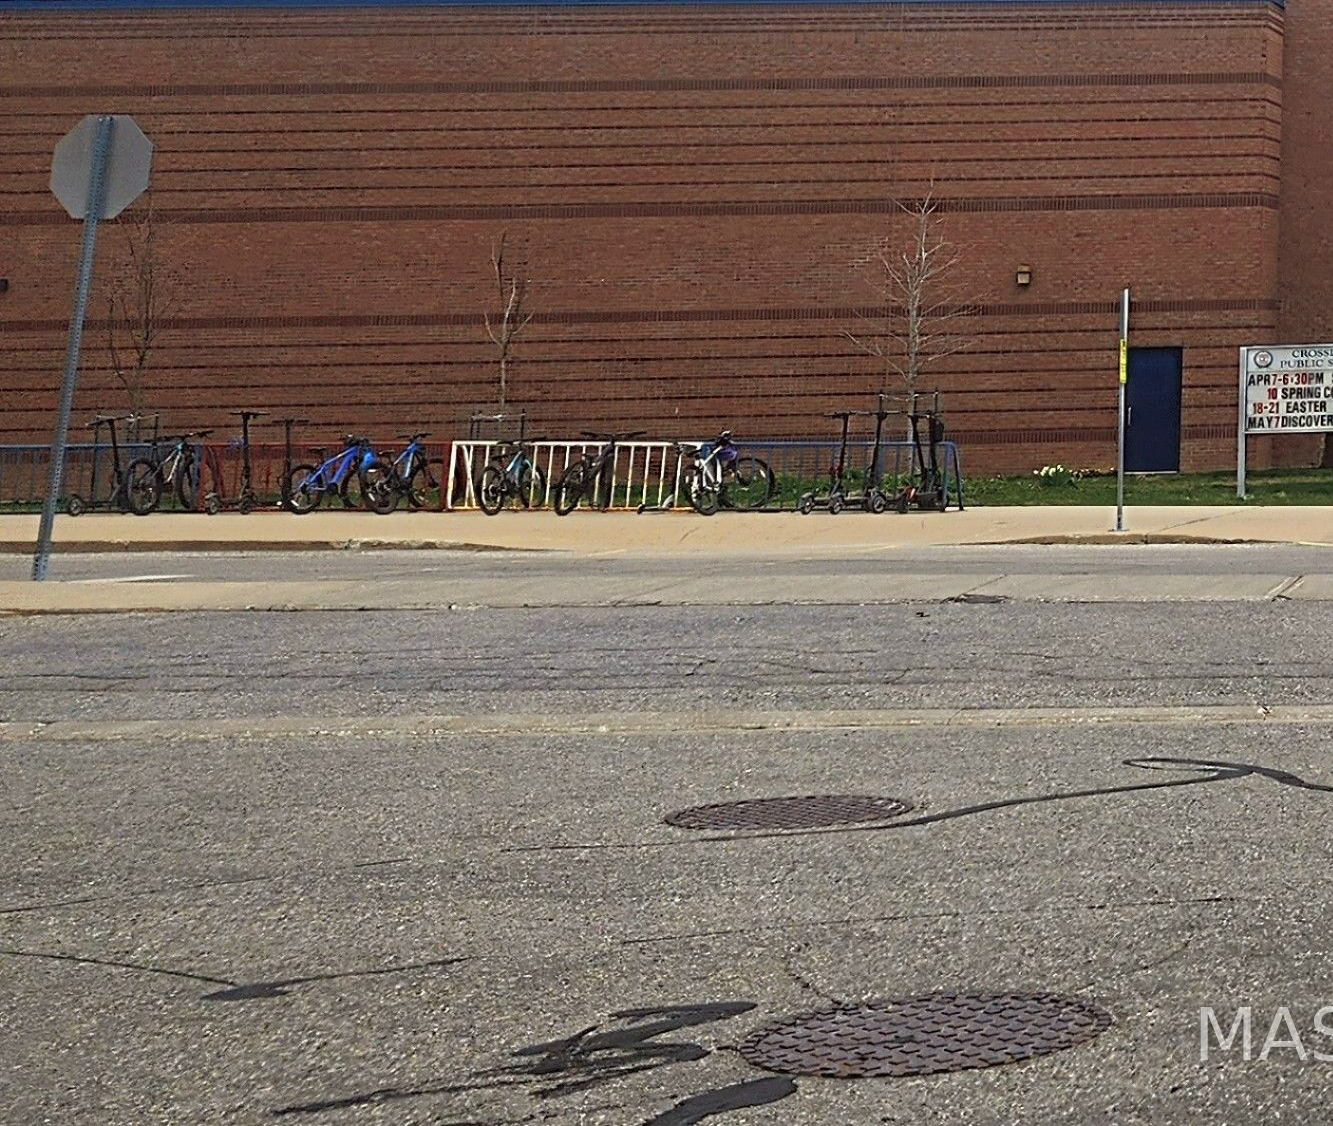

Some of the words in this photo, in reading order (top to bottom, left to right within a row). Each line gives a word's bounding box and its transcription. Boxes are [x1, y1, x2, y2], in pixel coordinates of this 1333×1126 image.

[1280, 359, 1324, 368] PUBLIC
[1267, 387, 1278, 400] 10
[1281, 386, 1321, 400] SPRING
[1253, 402, 1280, 415] 18-21
[1286, 400, 1327, 414] EASTER
